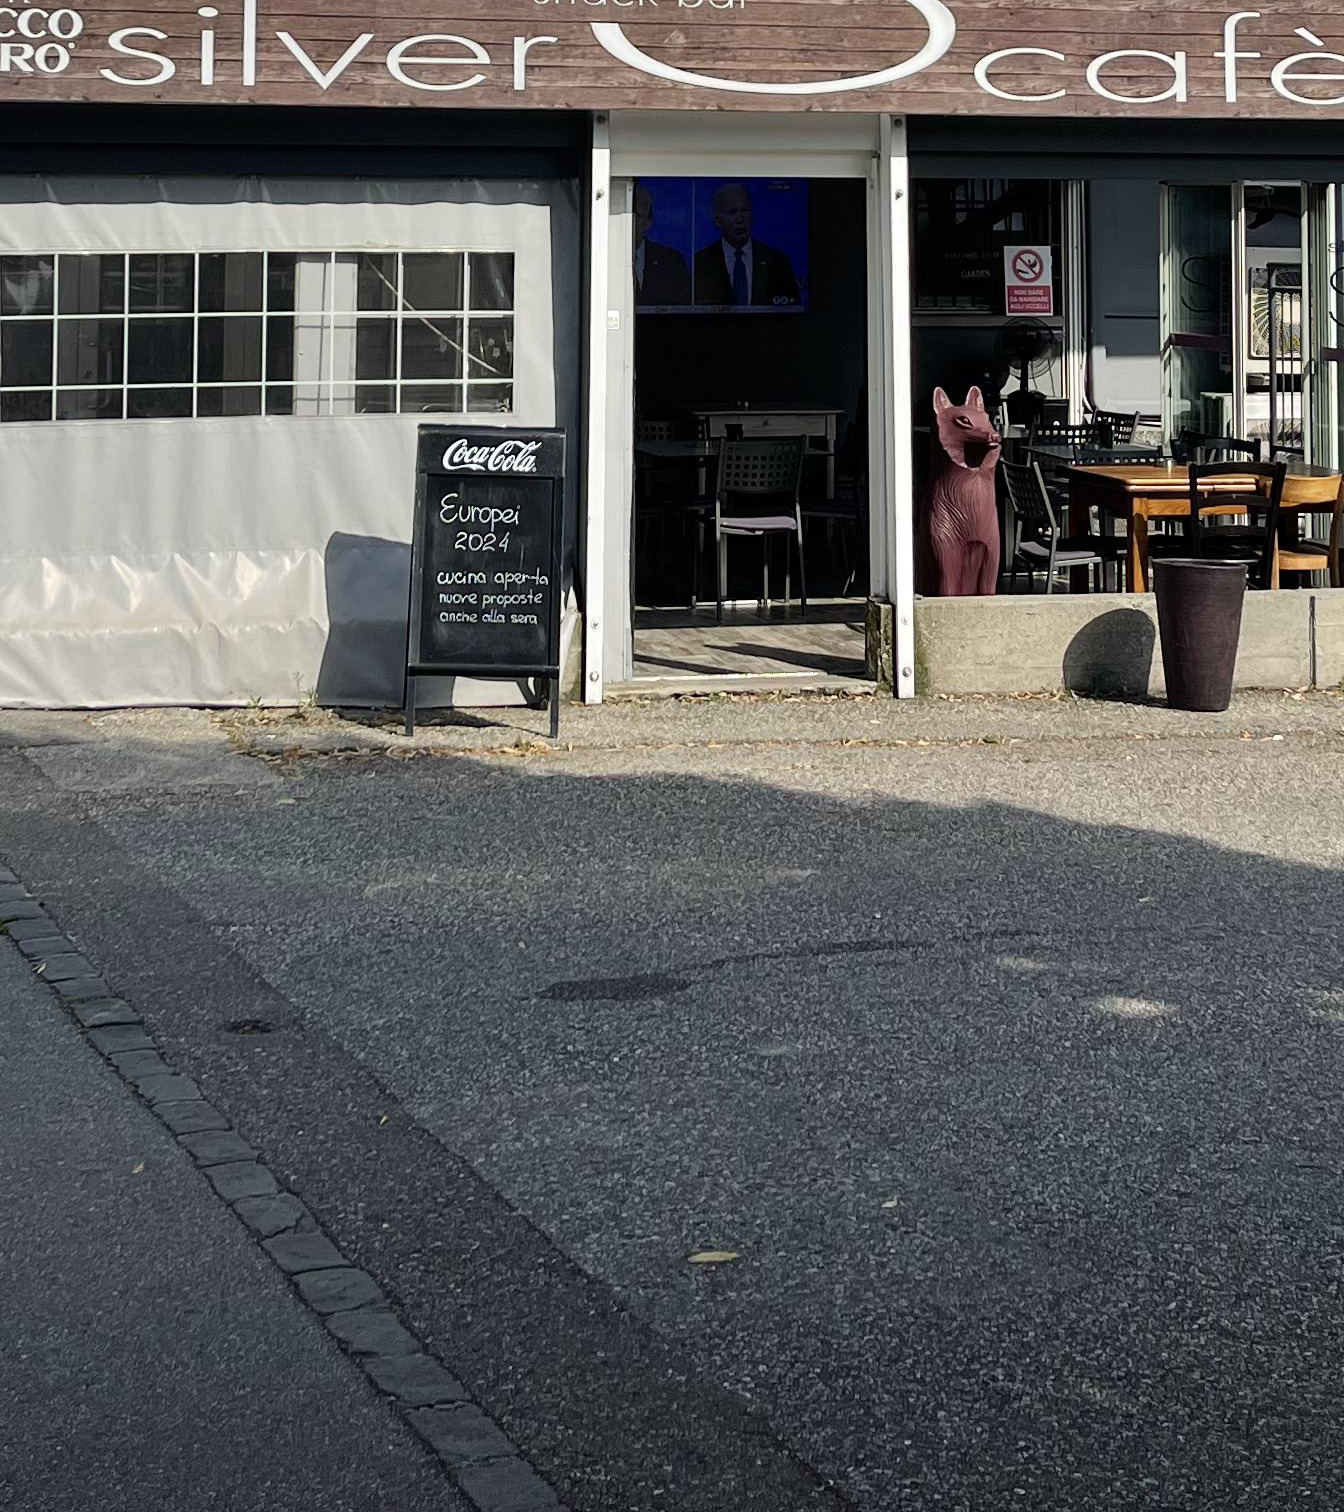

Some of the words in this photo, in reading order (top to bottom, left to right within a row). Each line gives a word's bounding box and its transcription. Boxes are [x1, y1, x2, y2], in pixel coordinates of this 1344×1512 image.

[442, 438, 543, 473] Coca-Cola
[439, 493, 522, 533] Europei
[454, 531, 511, 553] 2024
[436, 570, 487, 585] cucina
[493, 567, 549, 590] aperta
[482, 591, 544, 610] proposte
[439, 610, 478, 624] anche
[482, 610, 506, 624] alla
[510, 612, 539, 625] sera
